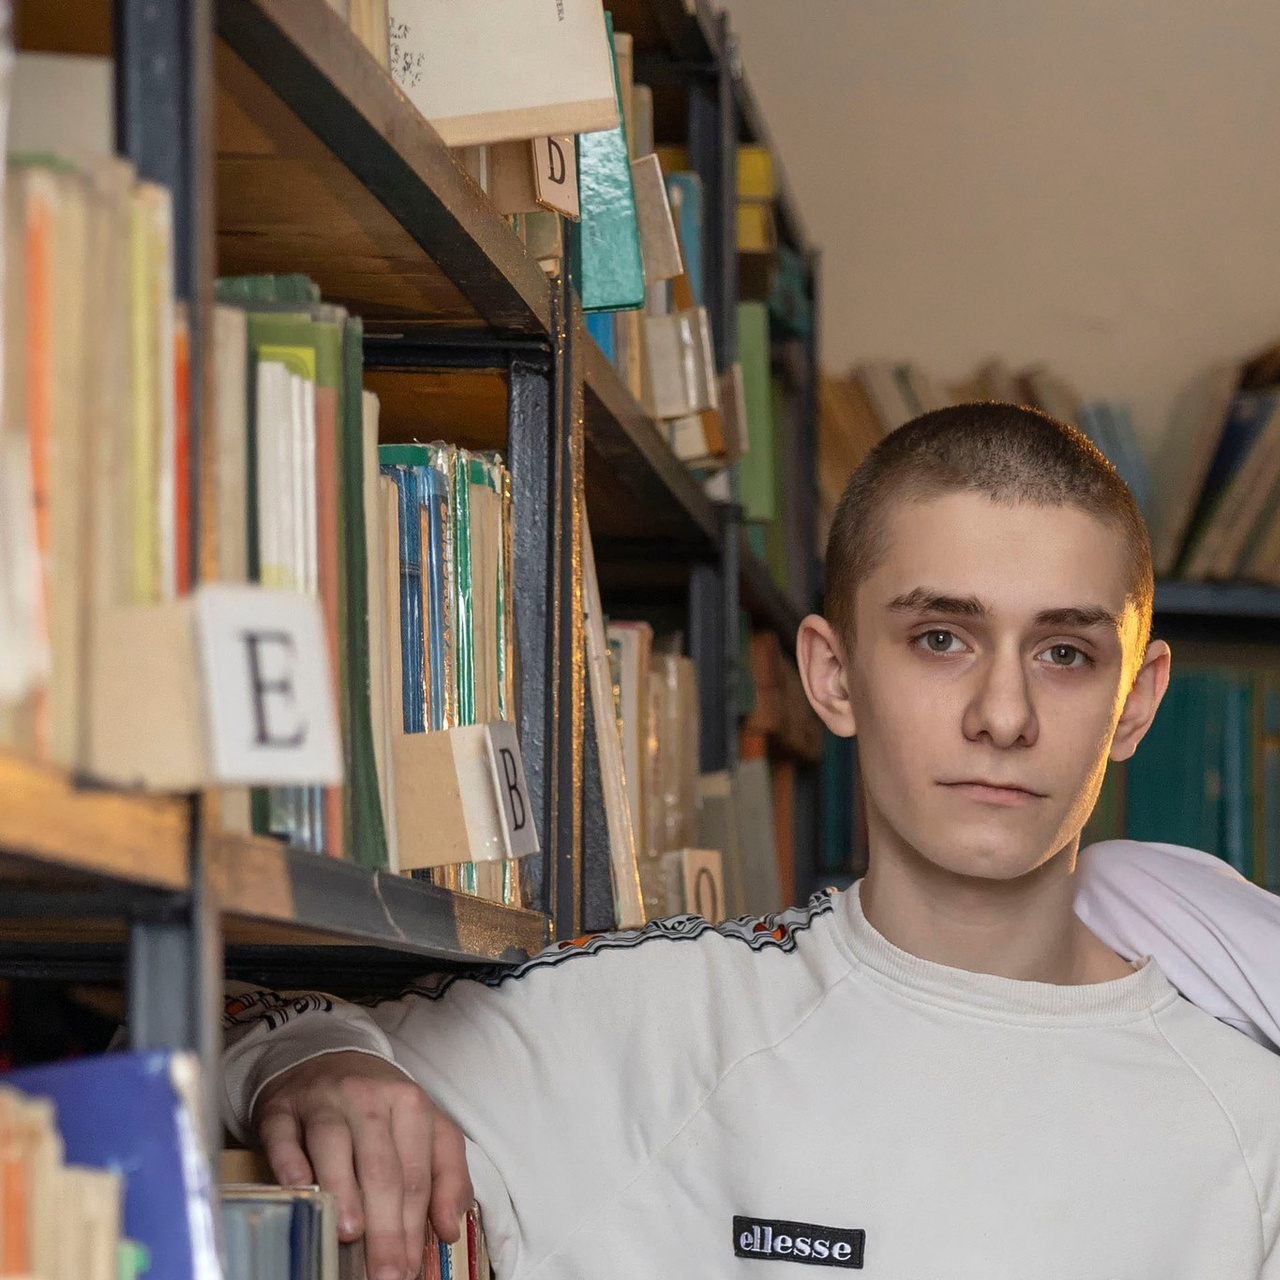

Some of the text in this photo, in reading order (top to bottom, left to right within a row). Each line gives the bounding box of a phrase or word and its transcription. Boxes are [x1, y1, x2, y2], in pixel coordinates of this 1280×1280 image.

[240, 626, 309, 749] Е
[500, 748, 526, 832] В
[739, 1225, 852, 1261] ellesse
